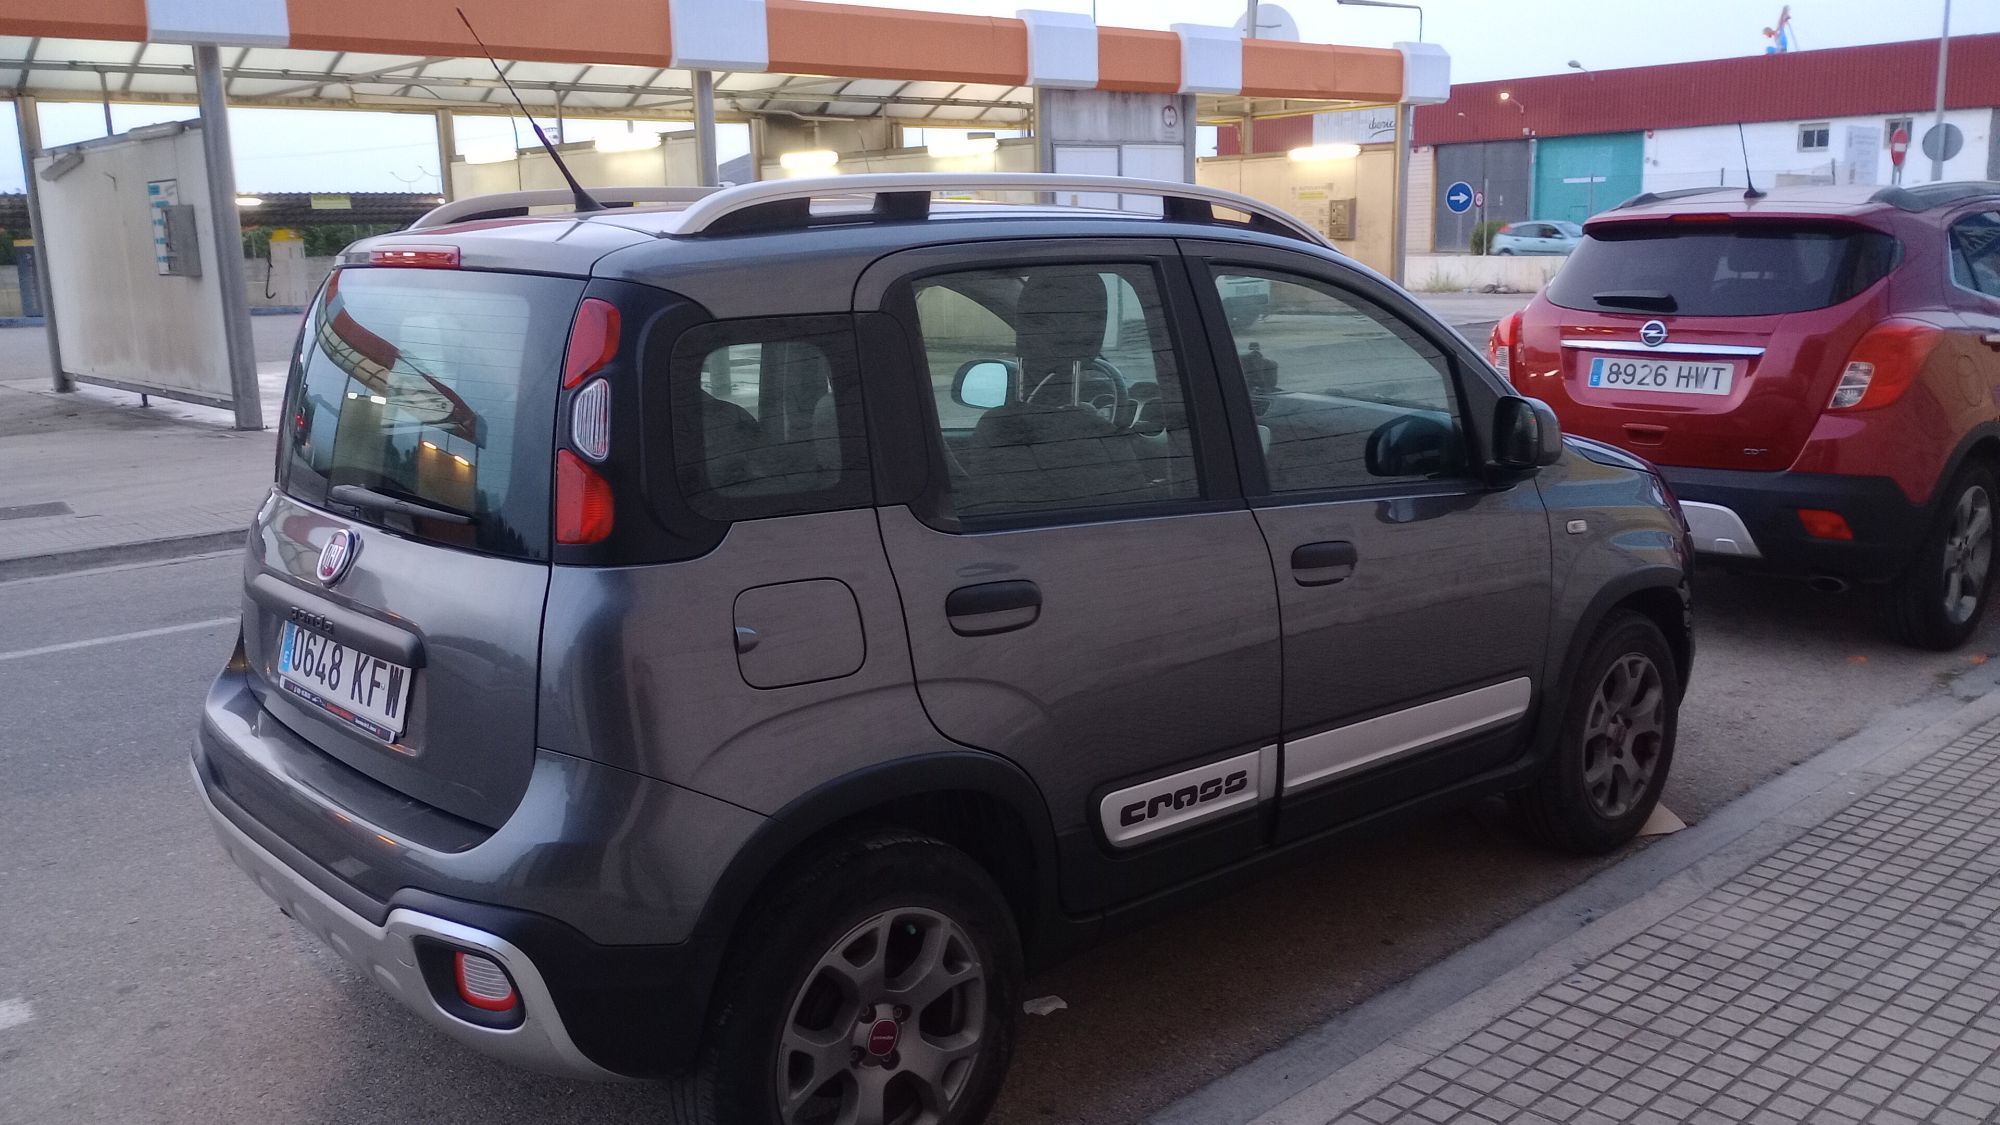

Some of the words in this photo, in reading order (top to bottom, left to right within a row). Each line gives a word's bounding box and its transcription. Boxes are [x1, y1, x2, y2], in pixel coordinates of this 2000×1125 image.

[1607, 362, 1668, 387] 8926
[1675, 365, 1726, 390] HWT
[292, 628, 343, 691] 0648
[351, 651, 404, 719] KFW
